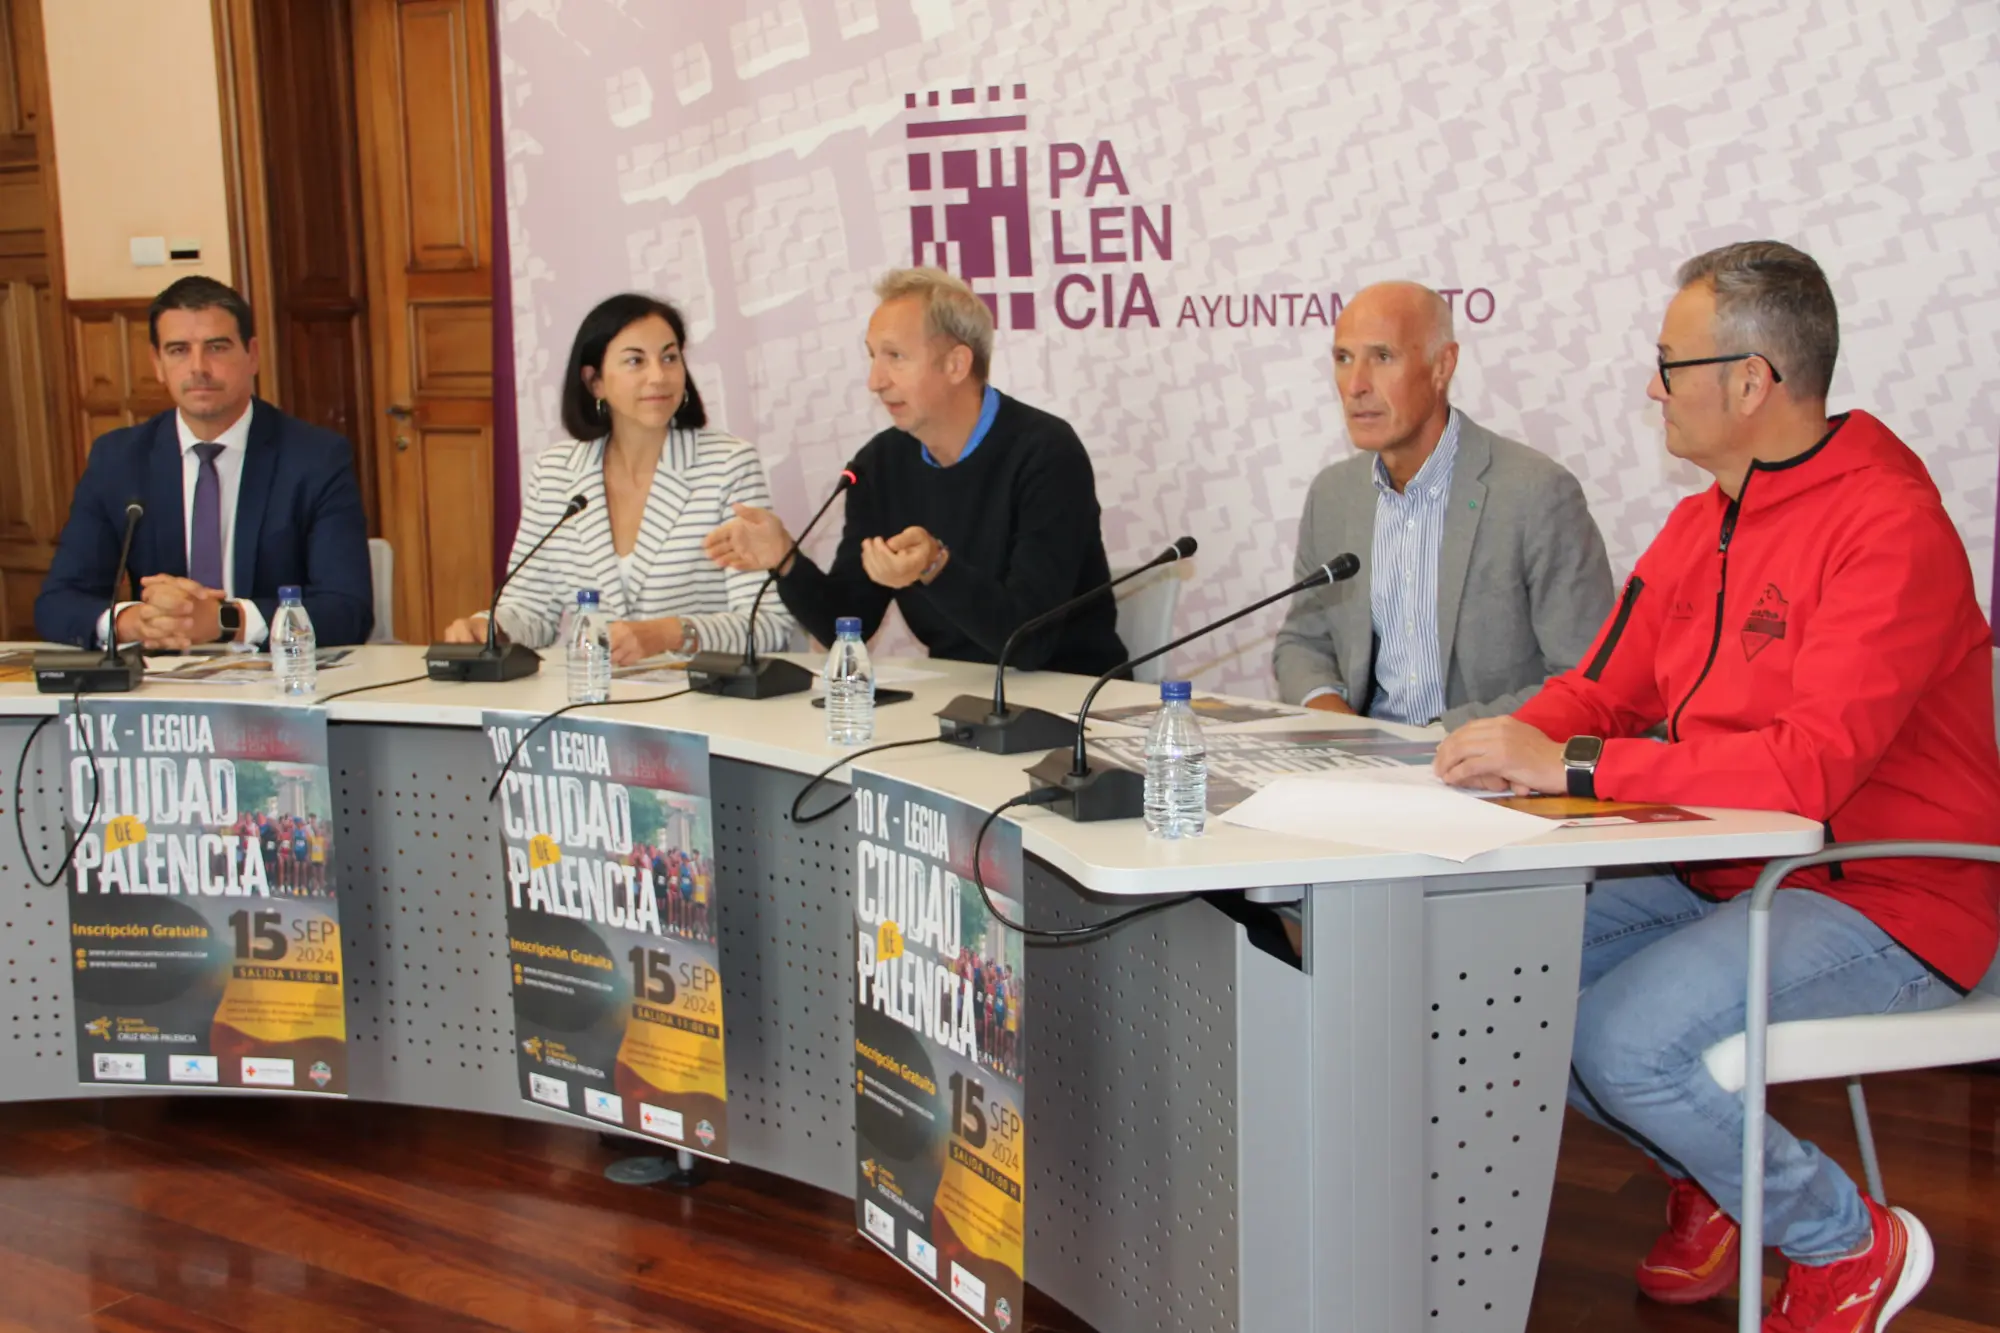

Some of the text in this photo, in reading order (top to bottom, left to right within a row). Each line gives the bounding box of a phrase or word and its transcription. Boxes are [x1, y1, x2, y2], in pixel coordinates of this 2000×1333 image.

[1048, 140, 1130, 199] PA
[1051, 204, 1173, 265] LEN
[1054, 273, 1161, 330] CIA
[1177, 288, 1495, 328] AYUNTATO
[65, 713, 94, 752] 10
[101, 714, 119, 752] K
[141, 714, 215, 753] LEGUA
[488, 726, 513, 765] 10
[516, 728, 532, 768] K
[551, 730, 611, 776] LEGUA
[70, 756, 238, 826] CIUDAD
[500, 771, 634, 855] CIUDAD
[114, 822, 132, 843] DE
[535, 839, 551, 861] DE
[855, 787, 874, 835] 10
[877, 792, 889, 841] K
[904, 800, 950, 863] LEGUA
[72, 832, 270, 898] PALENCIA
[507, 846, 662, 936] PALENCIA
[857, 839, 961, 960] CIUDAD
[72, 923, 208, 939] Inscripción Gratuita
[229, 909, 335, 961] 15 SEP
[296, 946, 335, 964] 2024
[510, 937, 613, 971] Inscripción Gratuita
[239, 966, 285, 980] SALIDA
[628, 945, 676, 1005] 15
[679, 962, 716, 992] SEP
[857, 931, 978, 1064] PALENCIA
[637, 1006, 675, 1027] SALIDA
[682, 992, 716, 1014] 2024
[949, 1070, 988, 1150] 15
[990, 1100, 1020, 1143] SEP
[952, 1145, 985, 1178] SALIDA
[992, 1139, 1020, 1173] 2024
